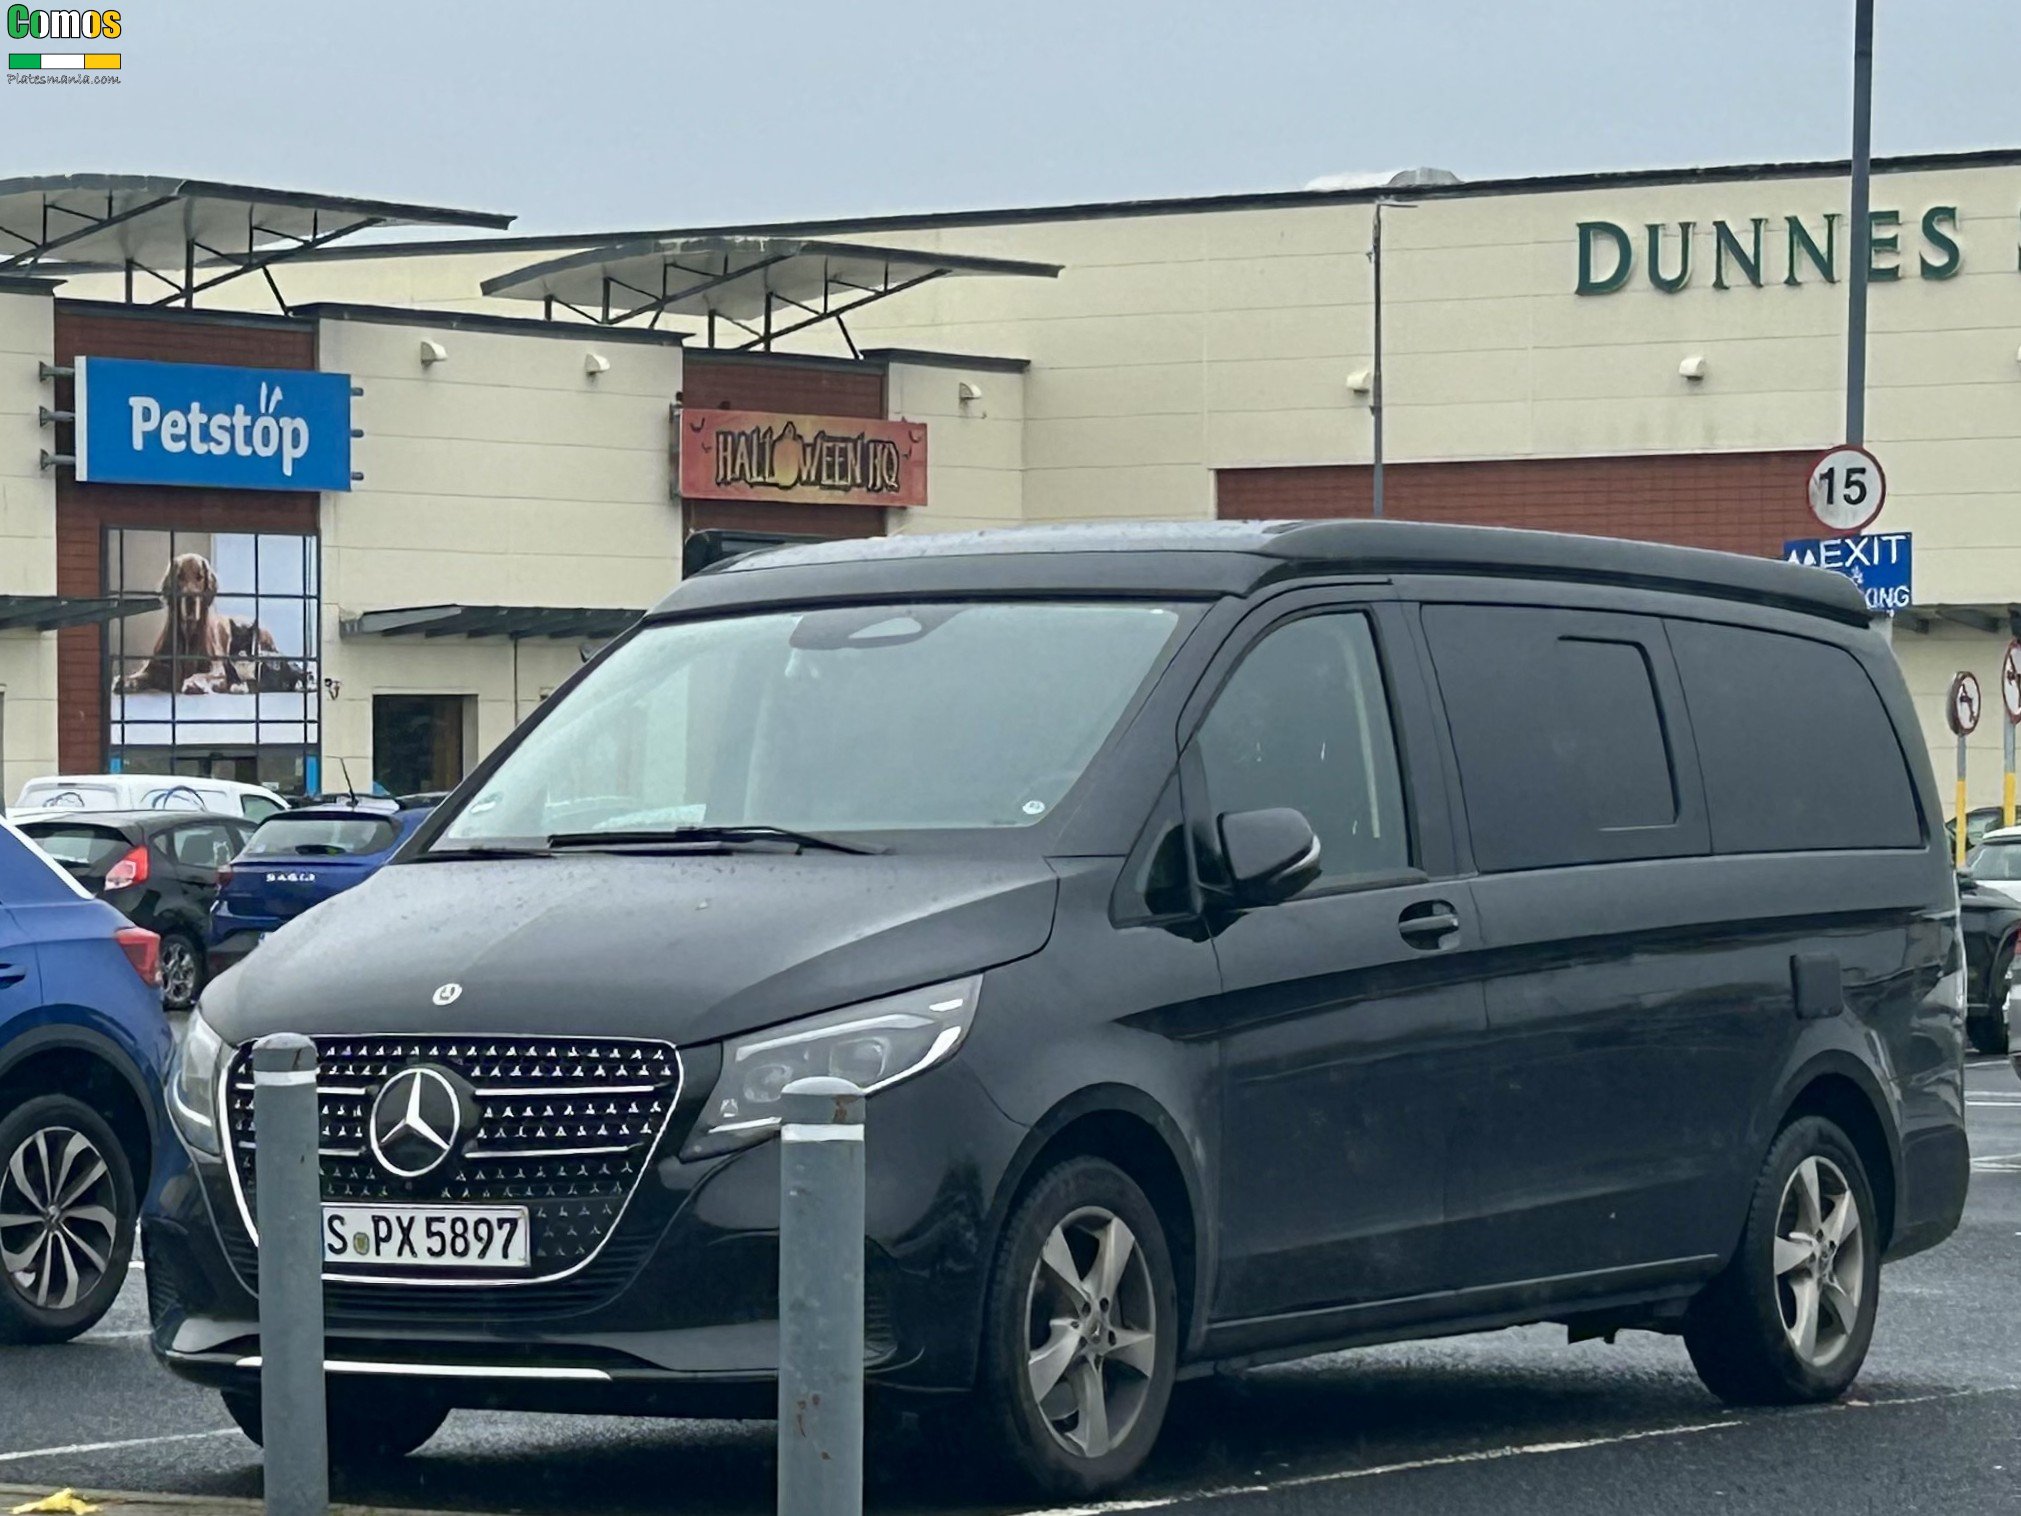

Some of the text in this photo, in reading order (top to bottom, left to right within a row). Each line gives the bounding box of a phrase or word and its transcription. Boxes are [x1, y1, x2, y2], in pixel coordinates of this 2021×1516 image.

[1575, 206, 1961, 296] DUNNES
[866, 439, 900, 492] HQ
[1819, 467, 1867, 505] 15
[1819, 535, 1906, 569] EXIT
[327, 1214, 518, 1260] S PX 5897
